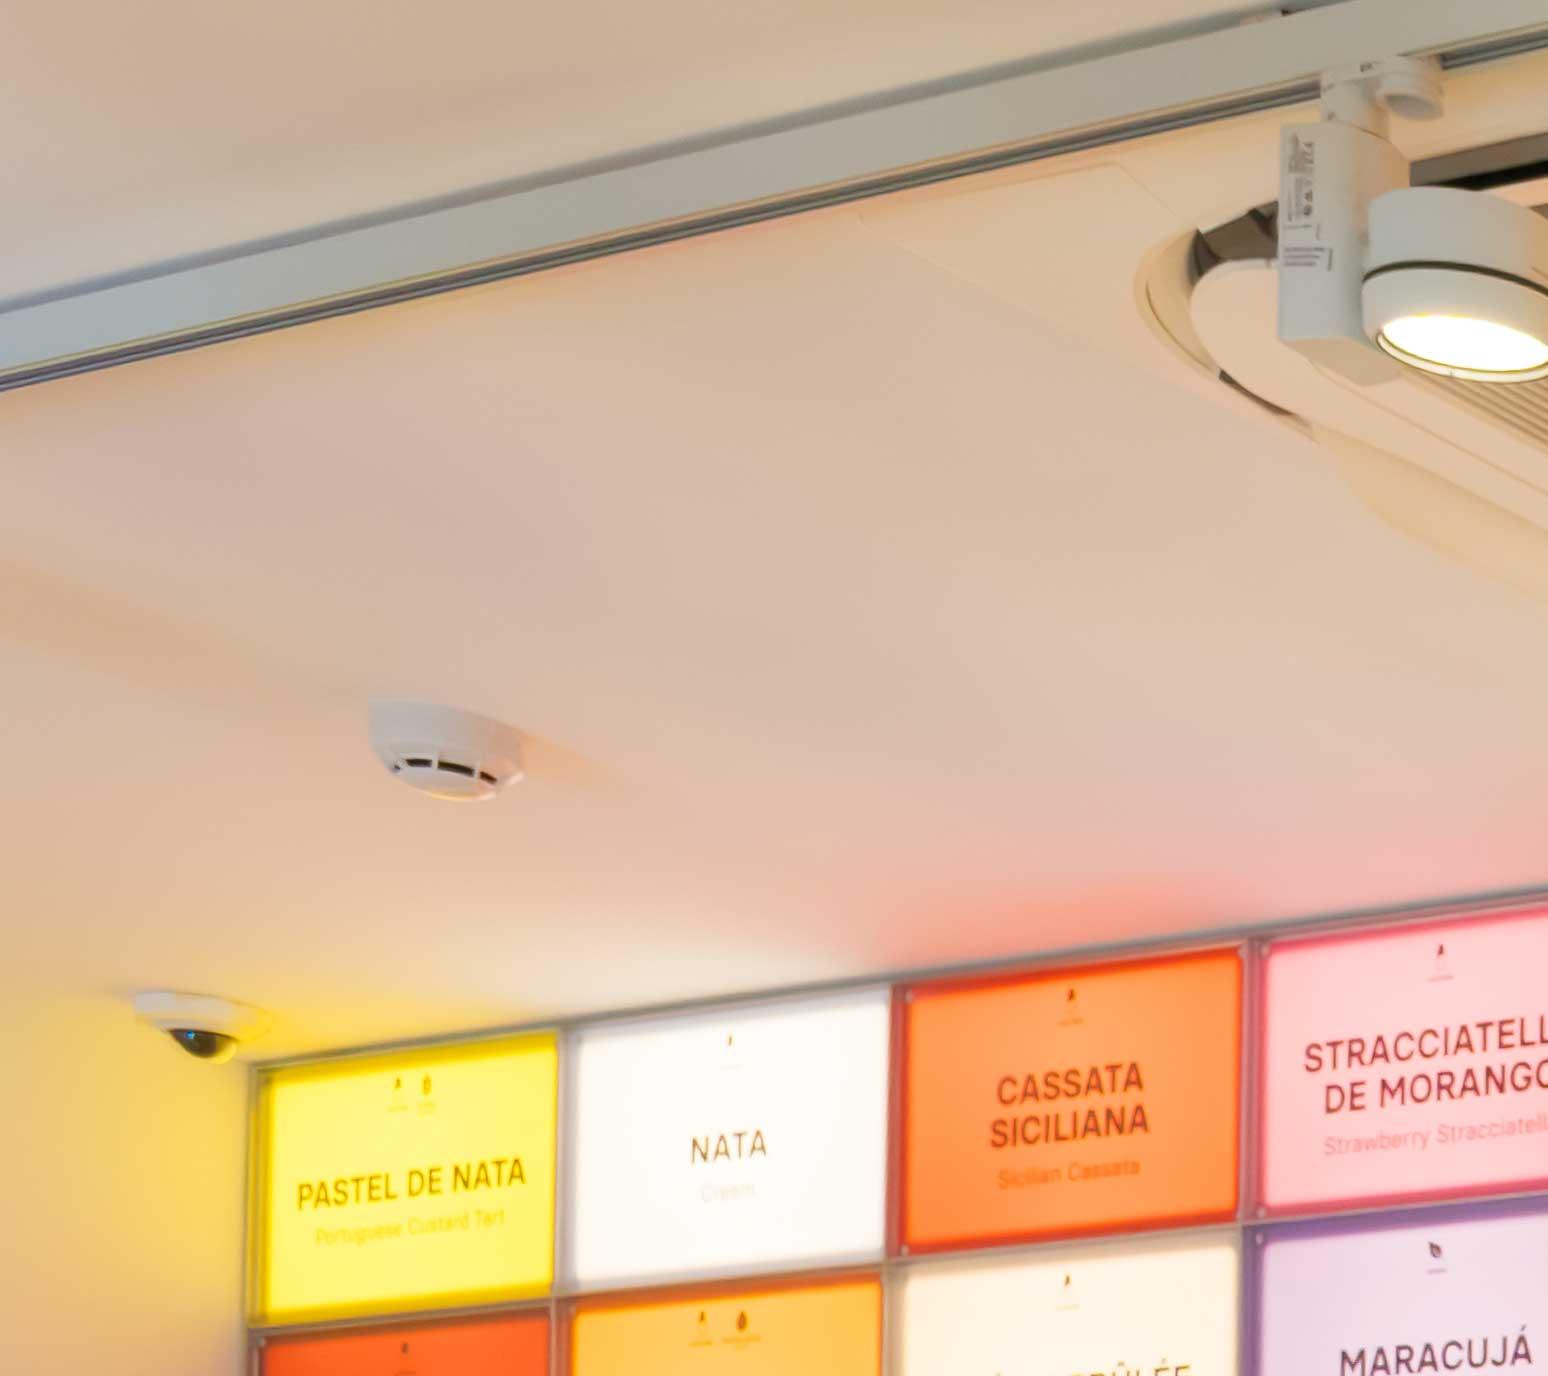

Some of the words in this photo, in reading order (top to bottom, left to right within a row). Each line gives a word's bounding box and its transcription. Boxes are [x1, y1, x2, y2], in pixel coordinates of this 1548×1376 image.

[996, 1062, 1143, 1106] CASSATA
[1323, 1081, 1365, 1114] DE
[990, 1104, 1148, 1148] SICILIANA
[1323, 1131, 1430, 1156] Strawberry
[690, 1130, 766, 1163] NATA
[296, 1173, 397, 1210] PASTEL
[408, 1167, 442, 1197] DE
[452, 1158, 524, 1191] NATA
